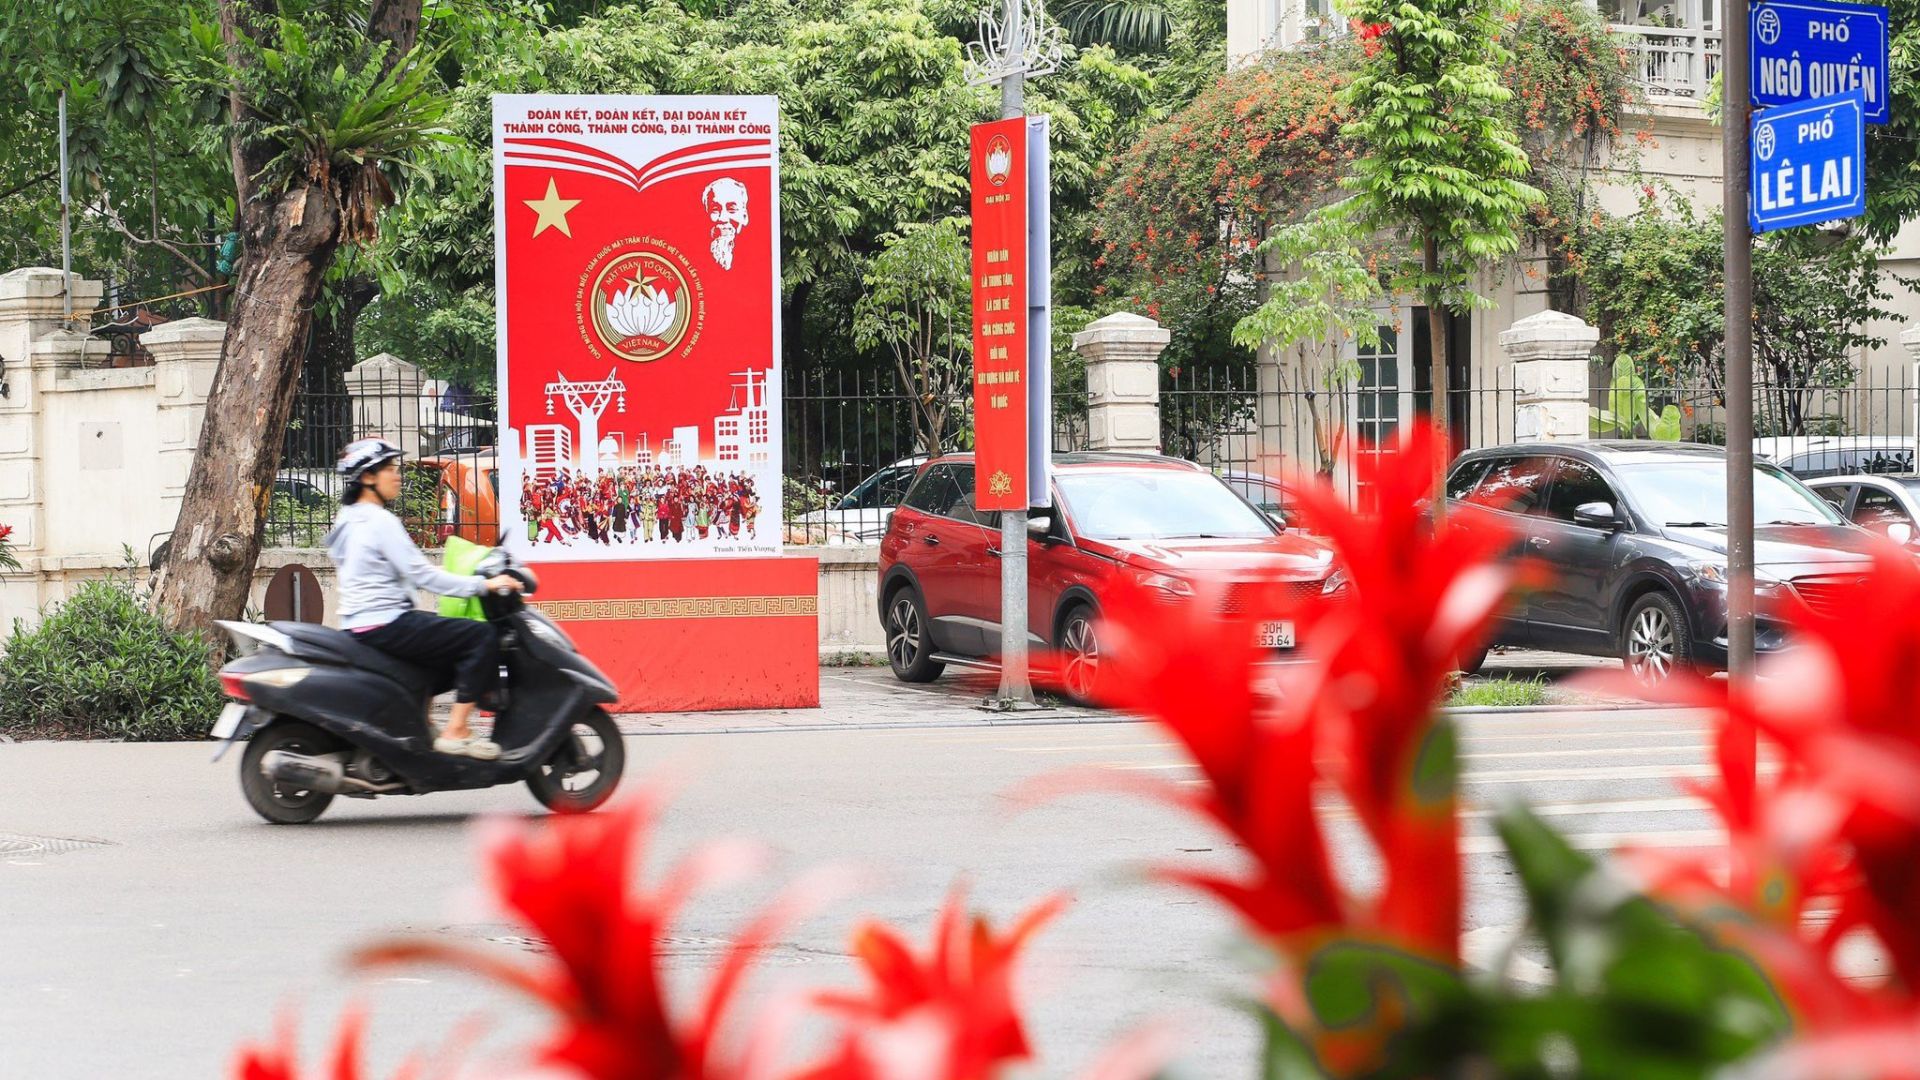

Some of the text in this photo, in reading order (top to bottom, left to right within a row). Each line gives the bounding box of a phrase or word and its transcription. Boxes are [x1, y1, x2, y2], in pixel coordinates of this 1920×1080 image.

[1808, 16, 1850, 42] PHỐ
[1760, 50, 1803, 97] NGÔ
[503, 122, 771, 136] THÀNH CÔNG, THÀNH CÔNG, ĐẠI THÀNH CÔNG
[527, 109, 747, 123] ĐOÀN KẾT, ĐOÀN KẾT, ĐẠI ĐOÀN KẾT
[1798, 110, 1834, 144] PHỐ
[1760, 156, 1851, 211] LÊ LAI
[586, 258, 598, 272] TOÀN
[651, 238, 667, 248] QUỐC
[641, 338, 660, 348] NAM
[1262, 623, 1282, 633] 30H
